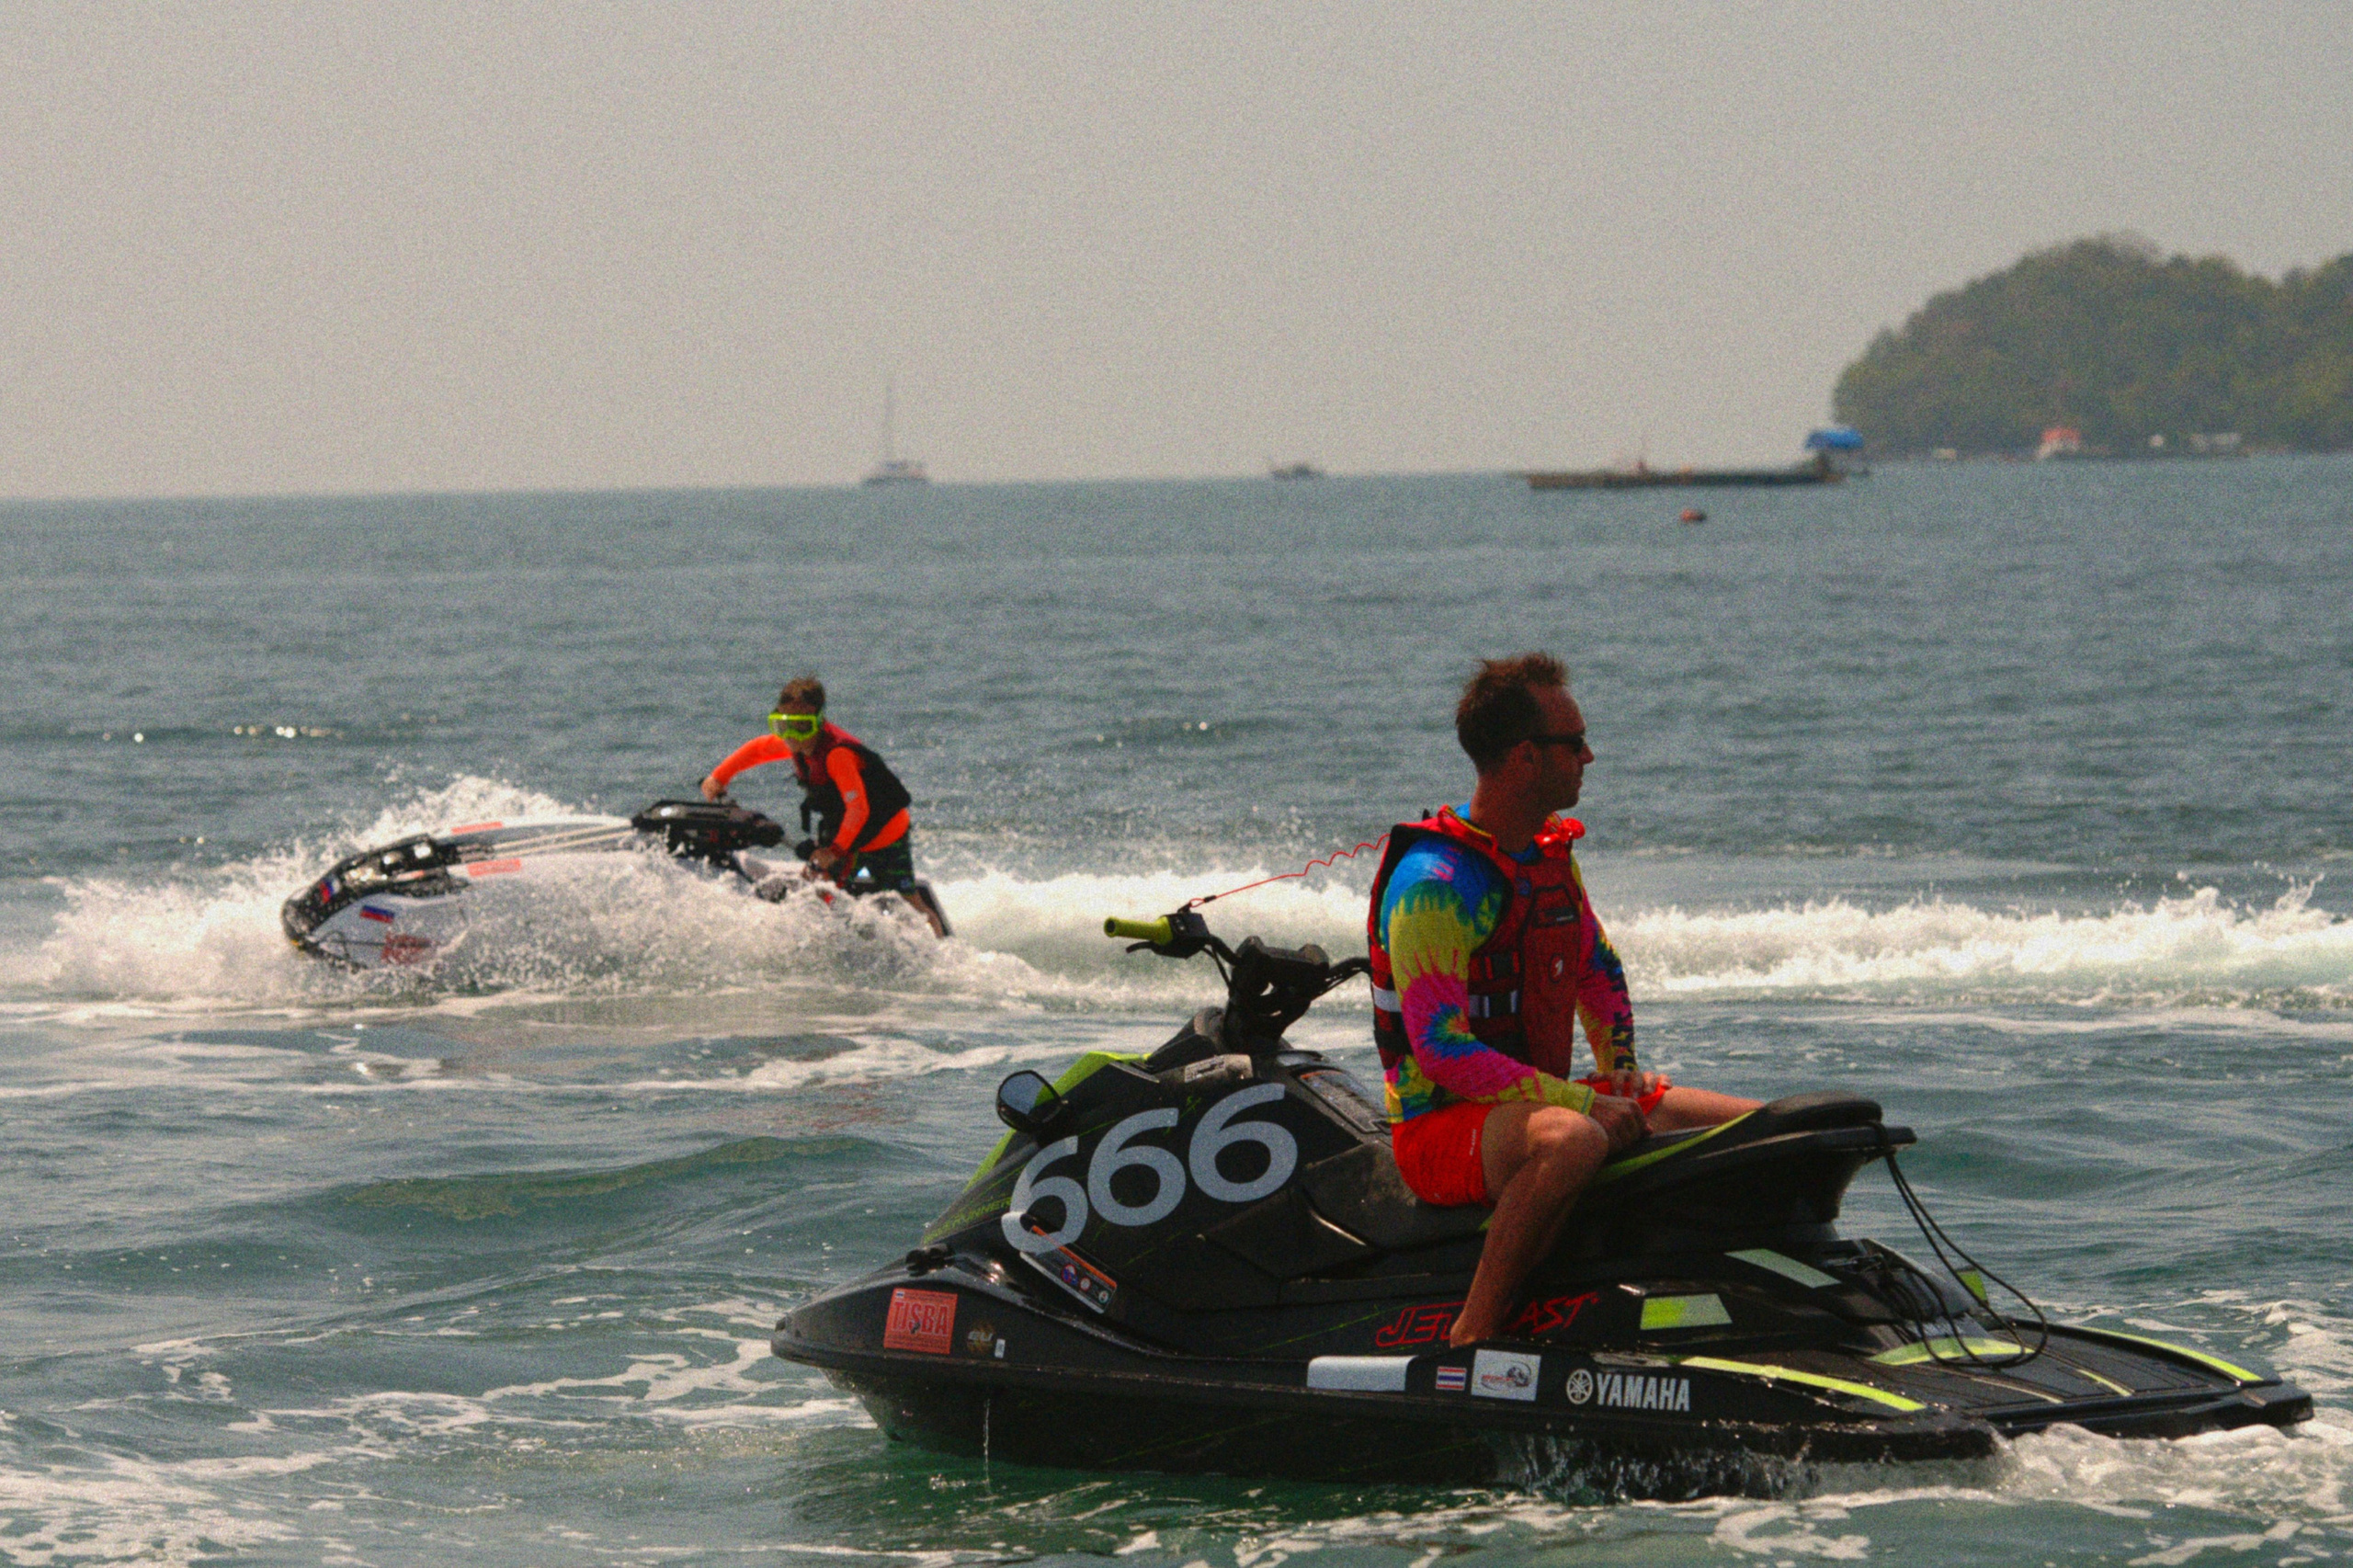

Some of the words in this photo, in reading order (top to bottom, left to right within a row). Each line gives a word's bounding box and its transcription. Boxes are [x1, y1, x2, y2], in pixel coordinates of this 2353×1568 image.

[1002, 1084, 1299, 1255] 666
[889, 1301, 949, 1337] TISBA
[1597, 1373, 1690, 1412] YAMAHA
